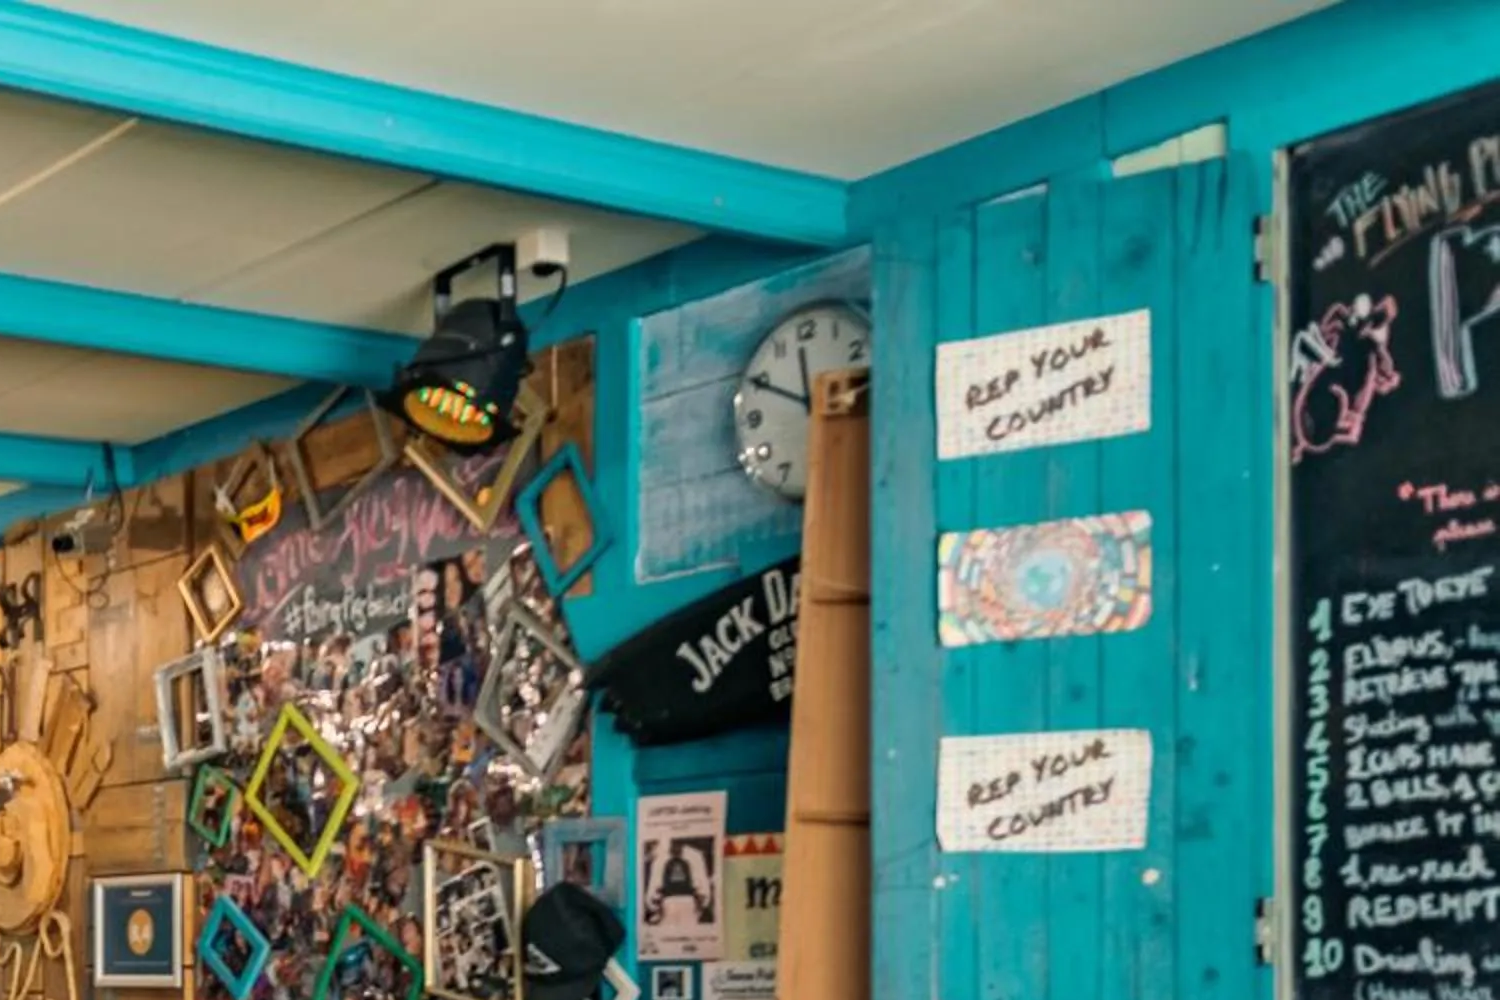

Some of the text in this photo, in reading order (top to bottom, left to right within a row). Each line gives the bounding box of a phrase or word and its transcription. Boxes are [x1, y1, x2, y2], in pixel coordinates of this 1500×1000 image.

[1326, 171, 1388, 228] THE
[798, 320, 816, 342] 12
[849, 340, 863, 362] 2
[965, 327, 1111, 410] REP YOUR
[747, 410, 762, 429] 9
[985, 365, 1115, 441] COUNTRY
[778, 462, 792, 482] 7
[1307, 597, 1332, 642] 1
[677, 595, 766, 694] JACK
[1309, 647, 1331, 683] 2
[1308, 683, 1329, 718] 3
[1305, 721, 1331, 755] 4
[966, 737, 1111, 809] REP YOUR
[1307, 755, 1329, 791] 5
[986, 776, 1115, 841] COUNTRY
[1306, 790, 1327, 820] 6
[1346, 782, 1368, 810] 2
[1305, 823, 1328, 855] 7
[1303, 857, 1322, 890] 8
[1348, 886, 1500, 930] REDEMPT
[1303, 938, 1343, 978] 10
